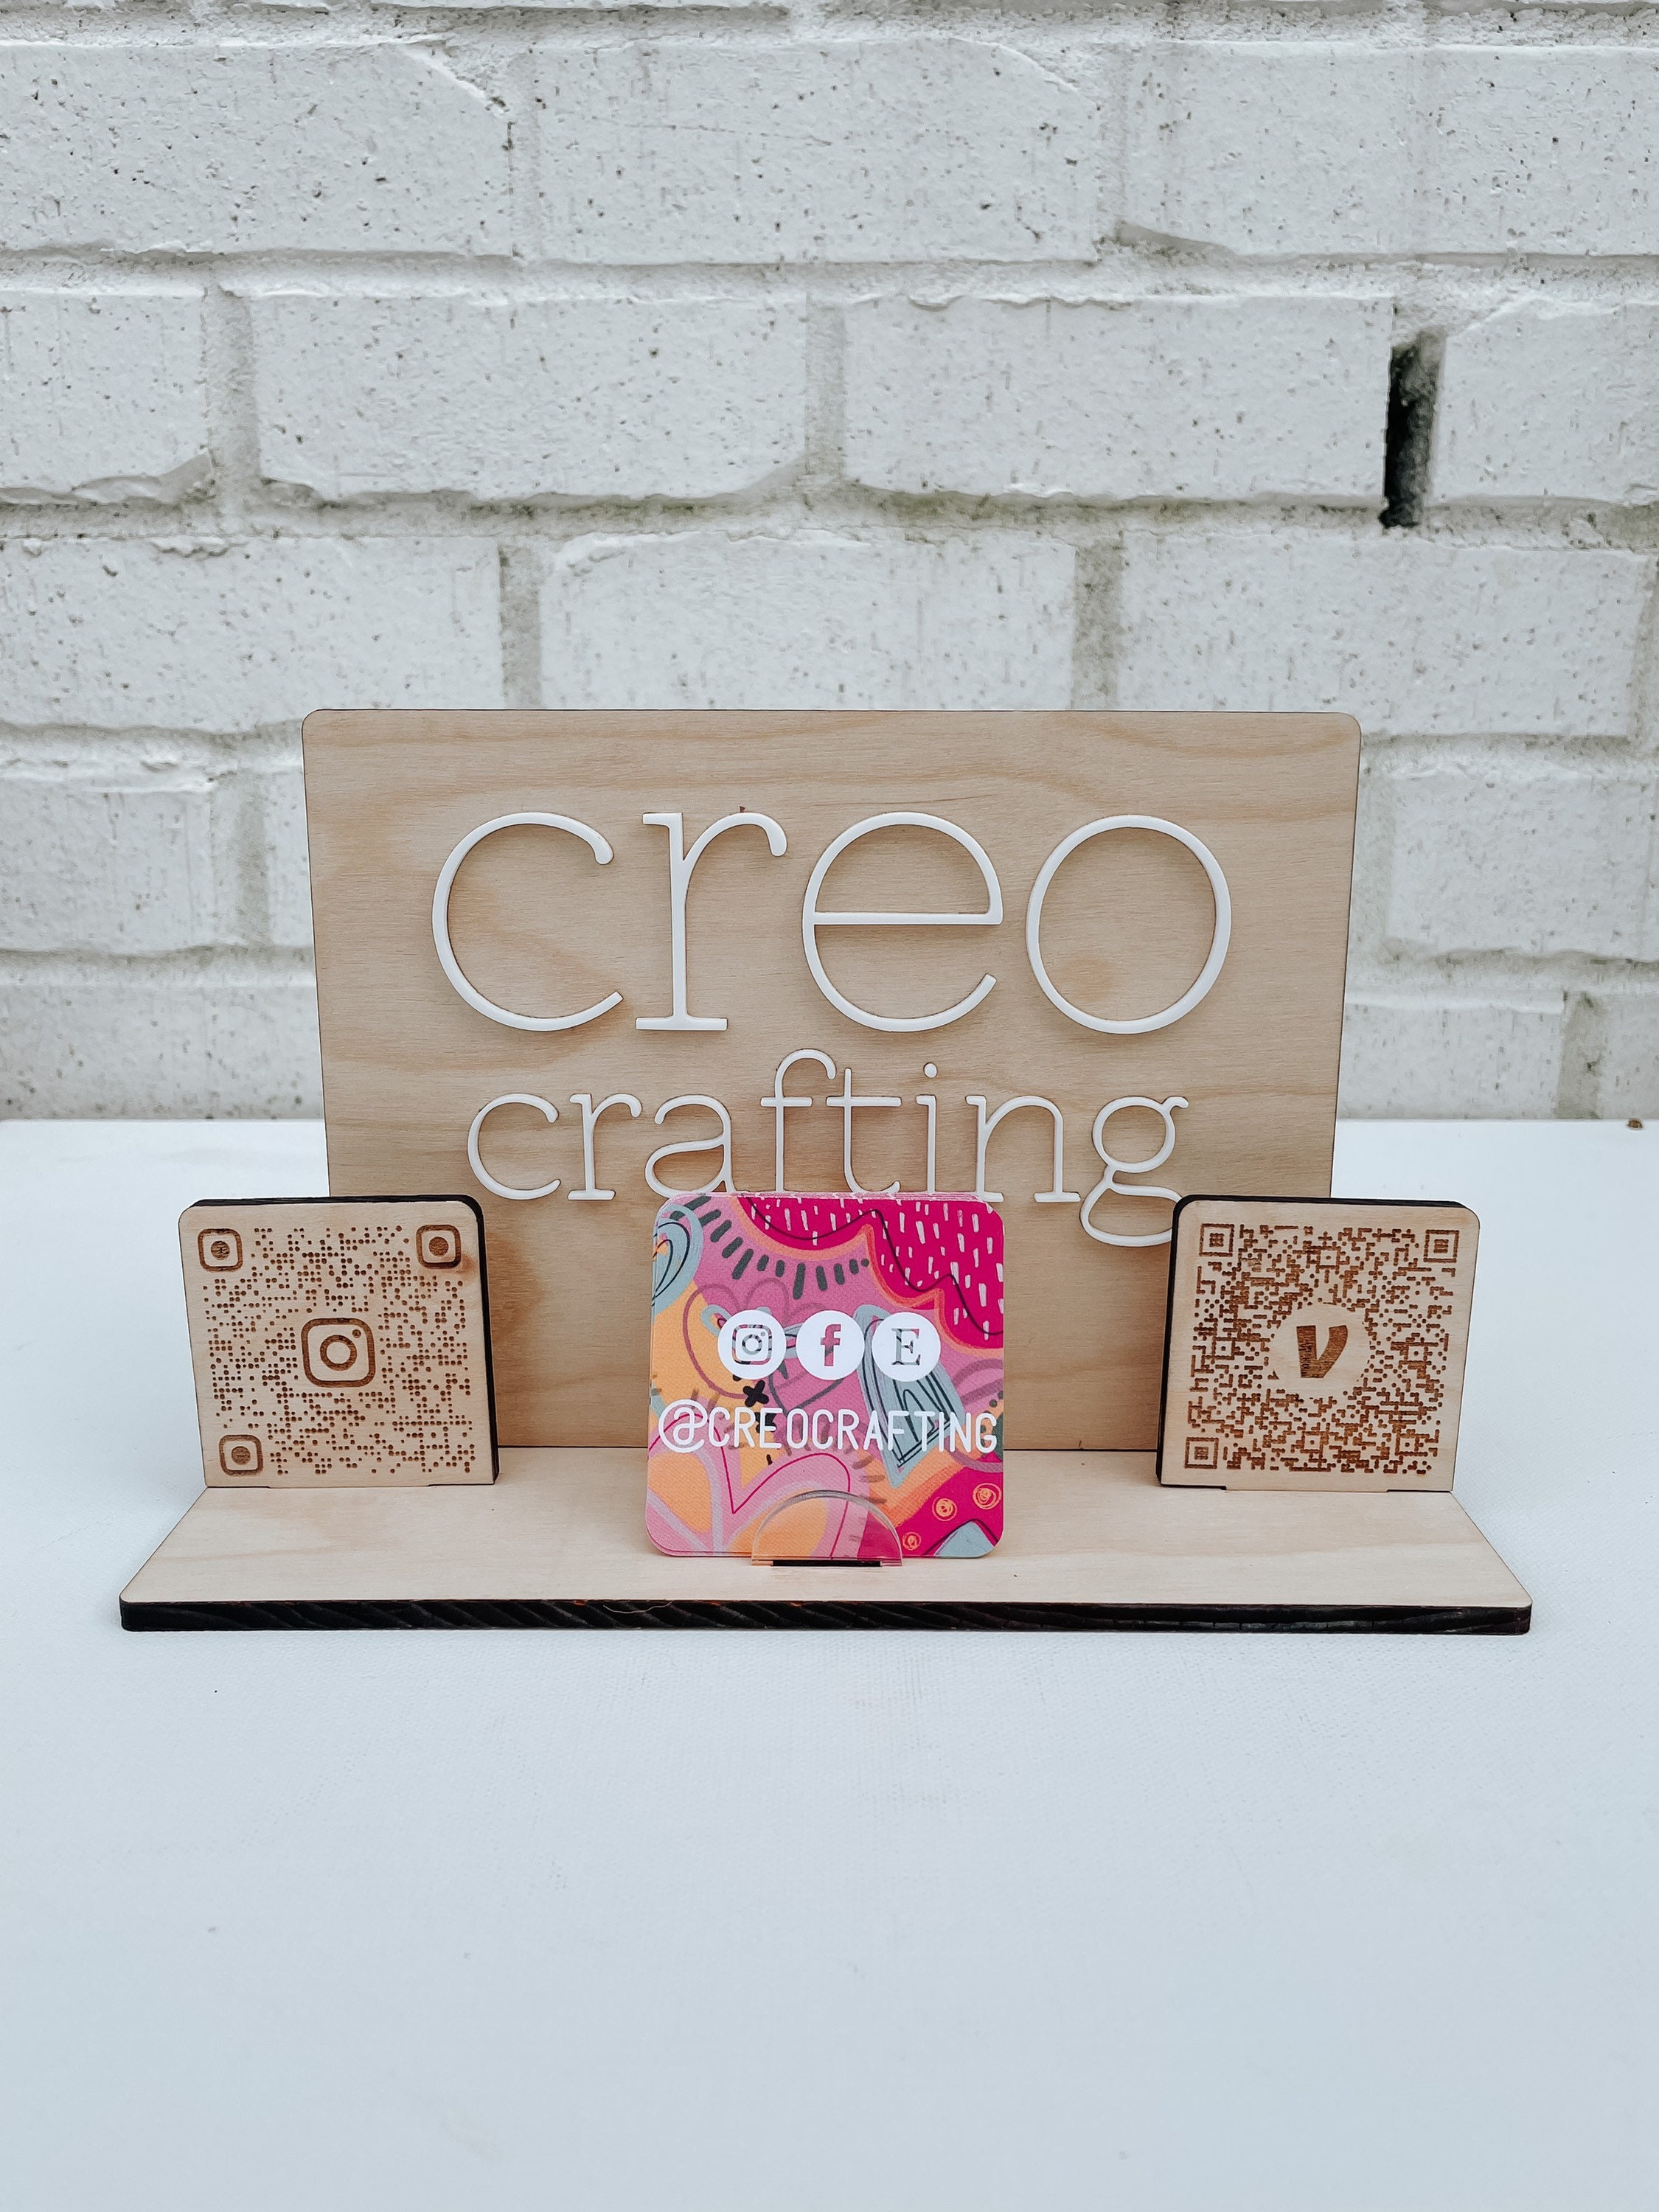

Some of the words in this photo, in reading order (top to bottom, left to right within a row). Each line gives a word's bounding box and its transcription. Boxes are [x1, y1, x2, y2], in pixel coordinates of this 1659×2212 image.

[432, 812, 1231, 1034] creo
[467, 1048, 1189, 1247] crafting
[658, 1399, 998, 1454] @CREOCRAFTING
